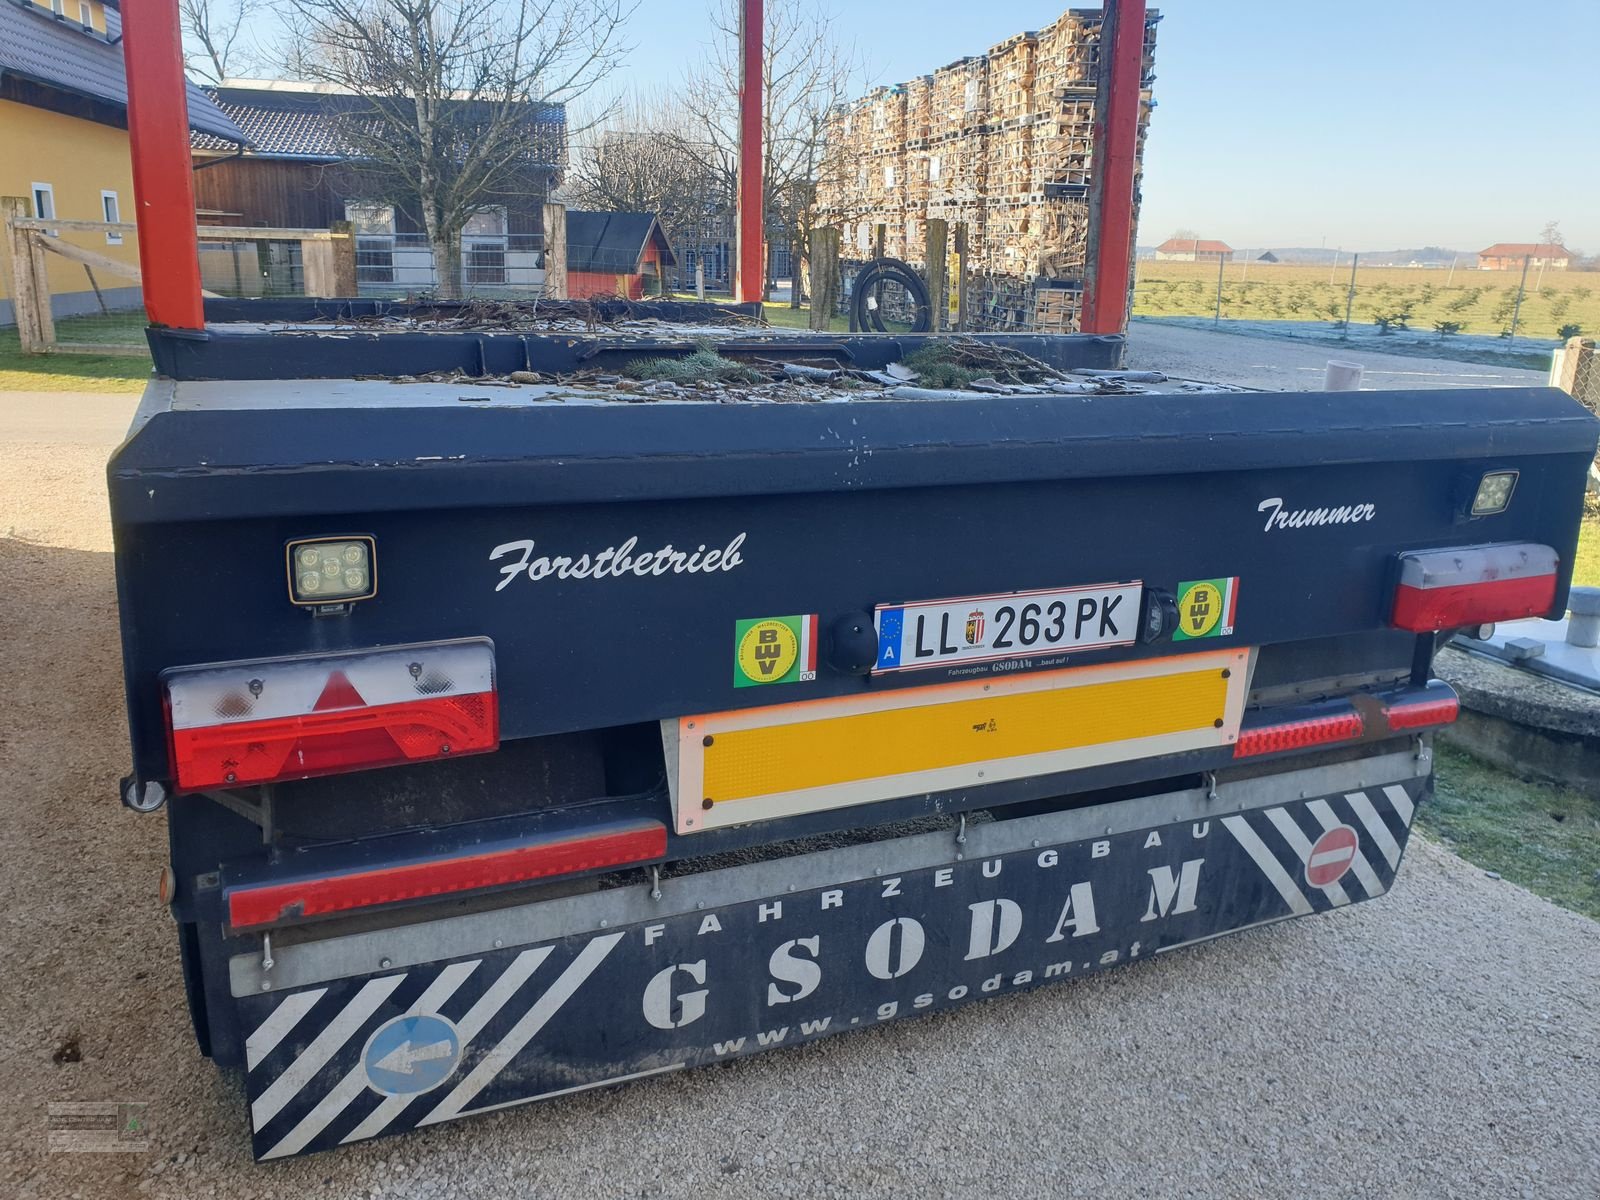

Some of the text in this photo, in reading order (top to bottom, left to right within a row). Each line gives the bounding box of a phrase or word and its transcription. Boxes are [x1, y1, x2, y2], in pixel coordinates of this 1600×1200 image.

[1258, 497, 1376, 532] Trummer
[489, 532, 746, 592] Forstbetrieb
[883, 646, 895, 660] A
[915, 612, 958, 657] LL
[948, 667, 988, 676] Fahrzeugbau
[992, 659, 1032, 672] GSODAM
[644, 821, 1210, 946] FAHRZEUGBAU
[642, 858, 1205, 1030] GSODAM
[713, 940, 1142, 1056] www.gsodam.at
